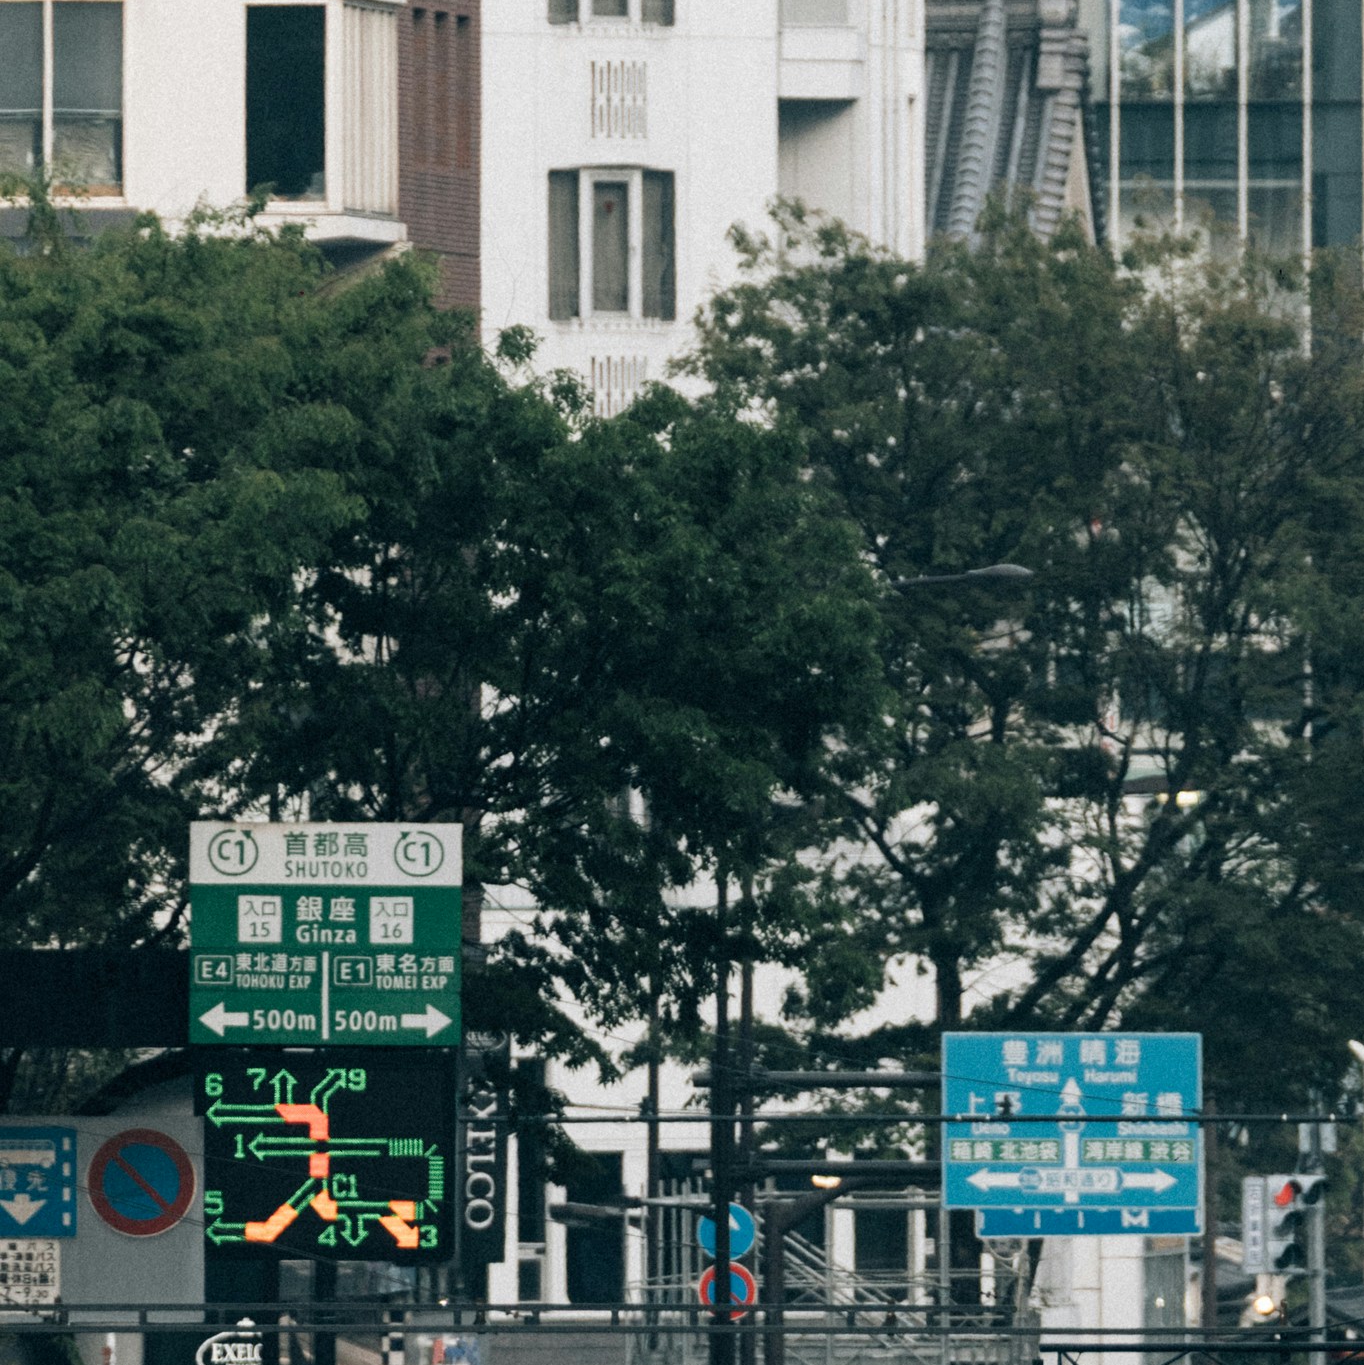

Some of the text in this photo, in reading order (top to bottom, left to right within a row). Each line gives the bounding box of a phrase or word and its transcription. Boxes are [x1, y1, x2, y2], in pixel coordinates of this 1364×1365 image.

[217, 839, 245, 865] C1
[284, 832, 369, 857] 首都高
[403, 841, 430, 867] C1
[285, 861, 368, 878] SHUTOKO
[243, 901, 277, 917] 入口
[296, 896, 356, 921] 銀座
[374, 902, 408, 918] 入口
[250, 922, 270, 937] 15
[296, 925, 357, 943] Ginza
[381, 923, 402, 938] 16
[201, 961, 227, 978] E4
[235, 953, 317, 972] 東北道方面
[340, 962, 366, 980] E1
[376, 954, 455, 973] 東名方面
[236, 974, 311, 989] TOHOKU EXP
[376, 976, 447, 989] TOMEI EXP
[253, 1009, 316, 1030] 500m
[335, 1010, 397, 1031] 500m
[1002, 1039, 1141, 1066] 豊洲 晴海
[205, 1073, 223, 1096] 6
[247, 1068, 266, 1090] 7
[348, 1068, 366, 1091] 9
[1084, 1069, 1138, 1084] Harumi
[234, 1134, 246, 1158] 1
[465, 1077, 497, 1229] XELCO
[999, 1141, 1059, 1161] 北池袋
[1083, 1141, 1193, 1162] 海岸線 渋谷
[332, 1173, 359, 1198] C1
[205, 1191, 224, 1215] 5
[318, 1226, 337, 1247] 4
[419, 1226, 438, 1247] 3
